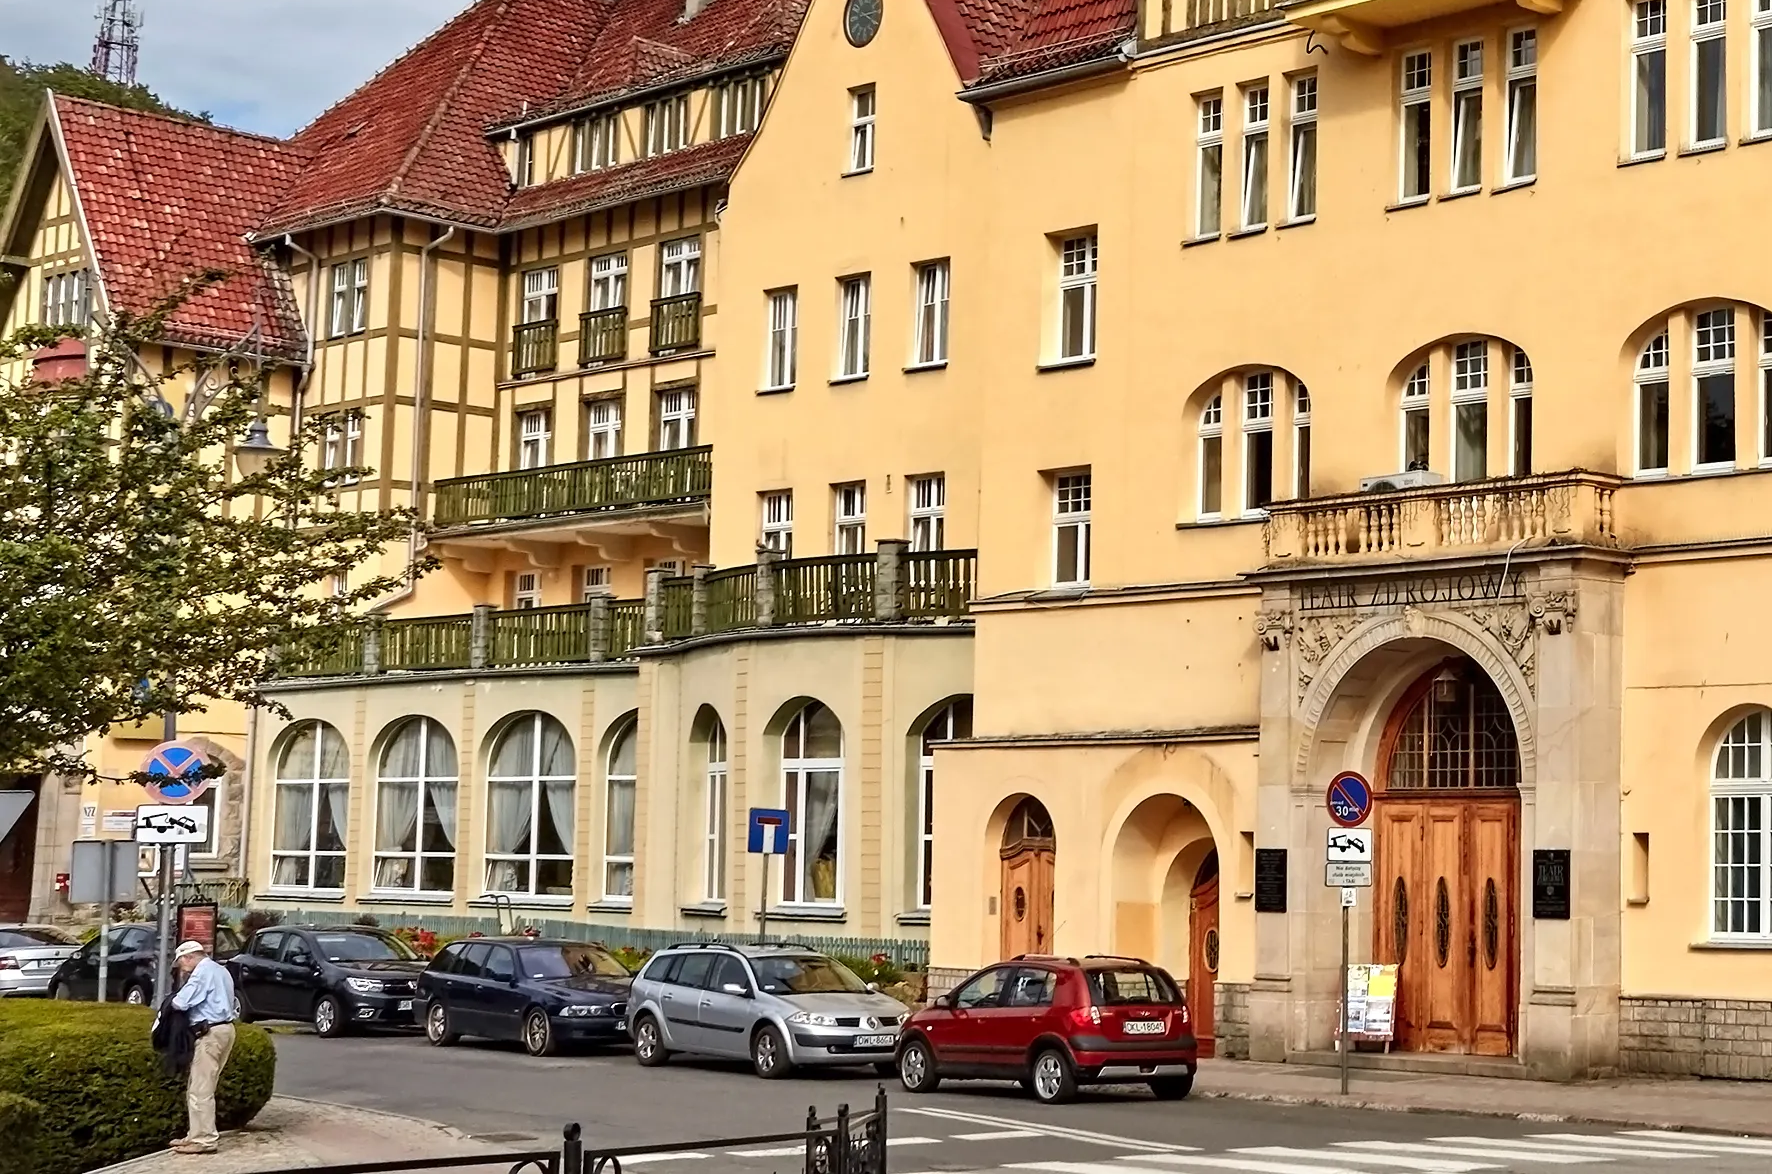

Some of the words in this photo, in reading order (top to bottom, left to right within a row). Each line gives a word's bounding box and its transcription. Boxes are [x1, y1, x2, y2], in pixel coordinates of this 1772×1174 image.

[1300, 582, 1358, 610] TEATR
[1371, 571, 1525, 606] ZDROJOWY
[1336, 805, 1349, 817] 30
